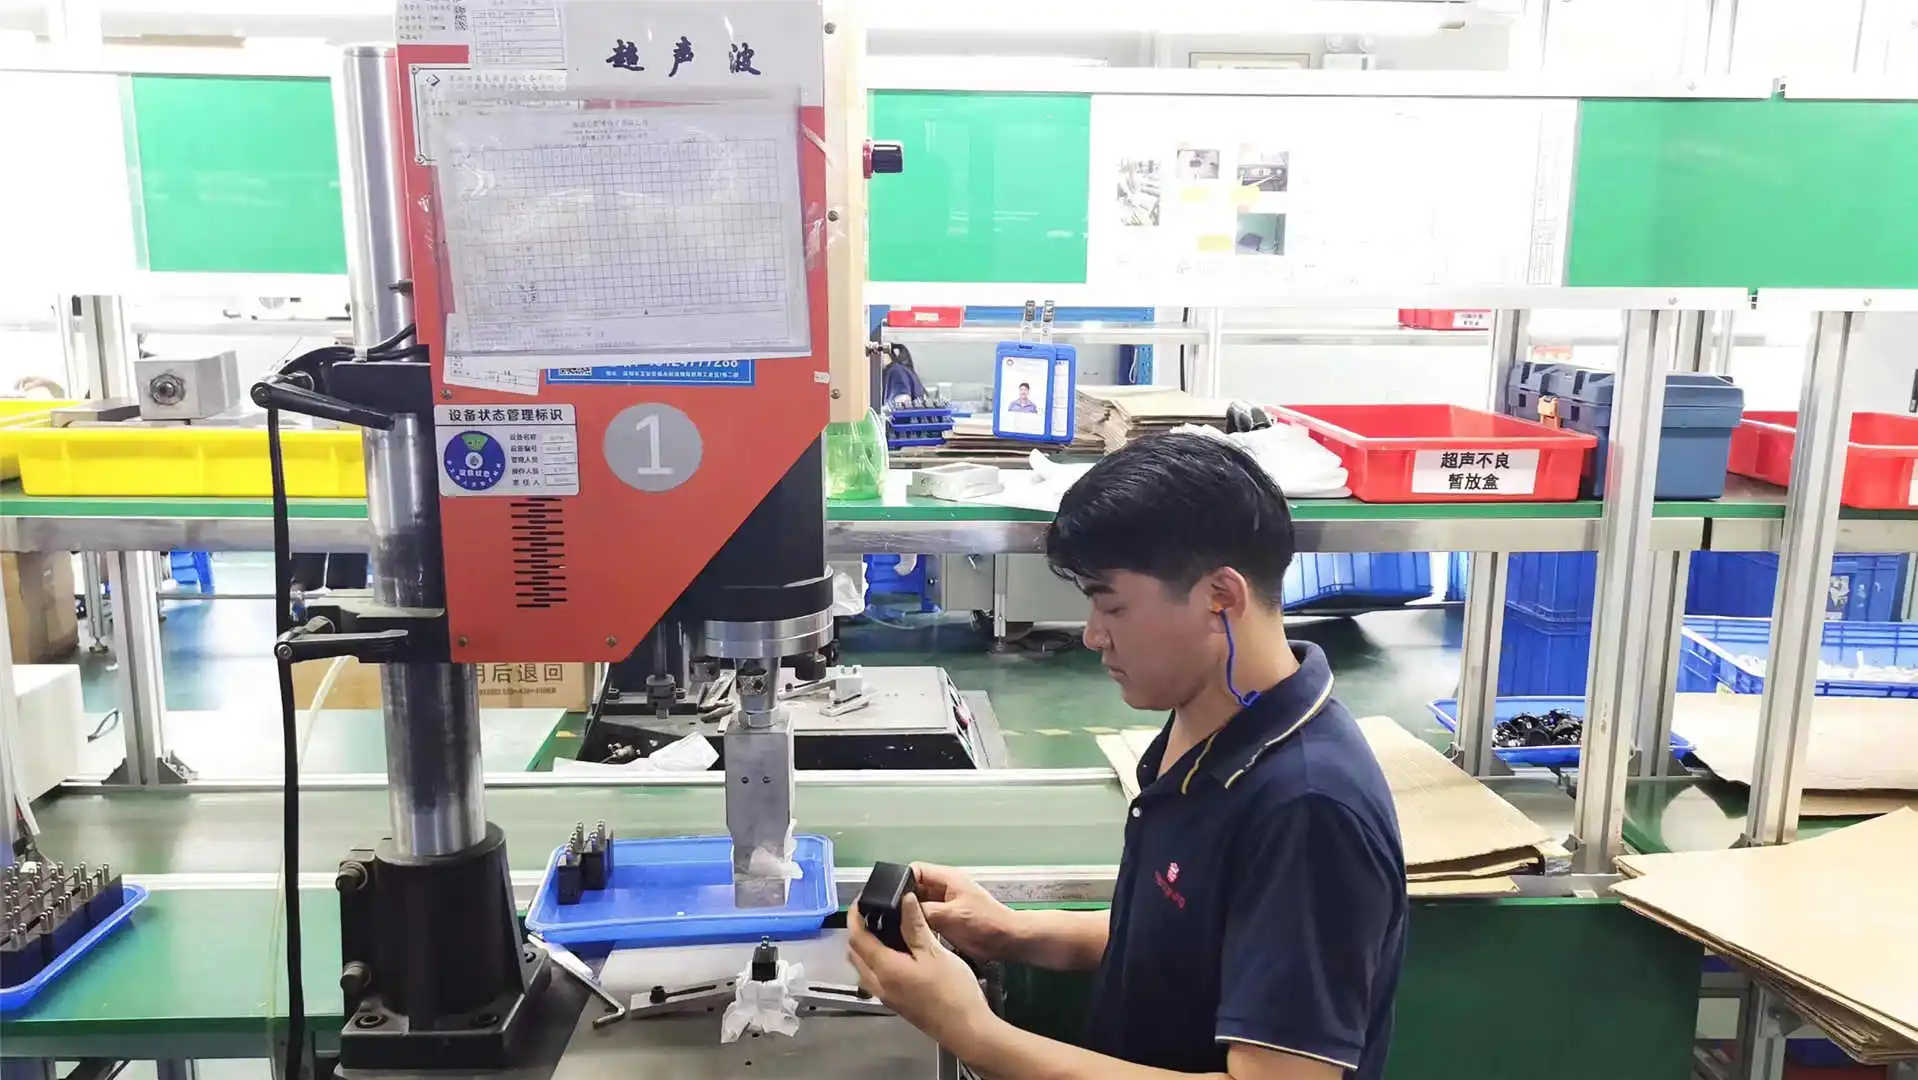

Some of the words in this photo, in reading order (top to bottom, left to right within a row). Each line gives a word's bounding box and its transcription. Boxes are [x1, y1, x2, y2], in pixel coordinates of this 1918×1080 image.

[606, 36, 762, 77] 超声波
[448, 408, 564, 422] 设备状态管理标识
[635, 413, 674, 476] 1
[1440, 452, 1511, 469] 超声不良
